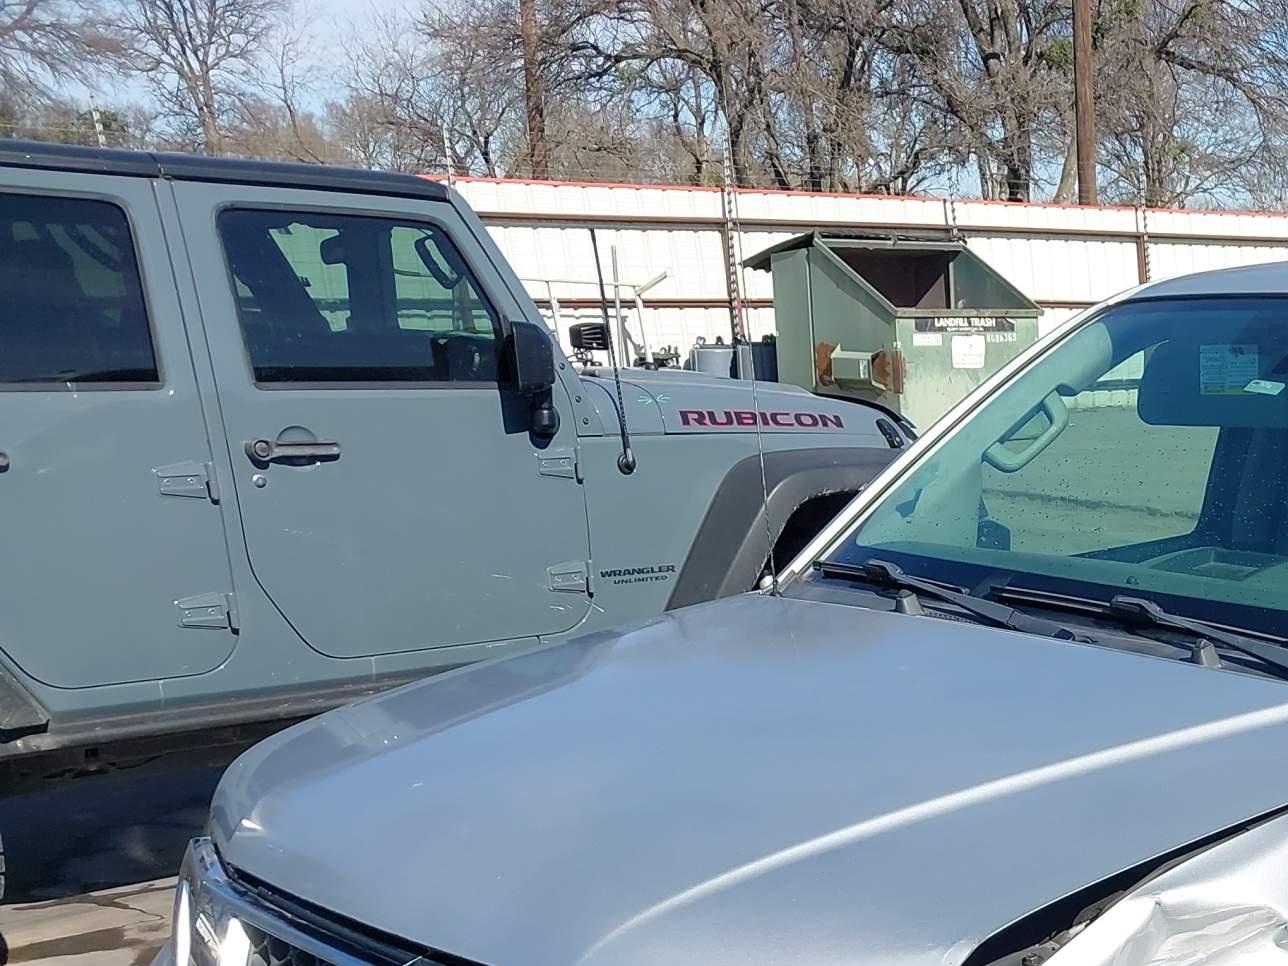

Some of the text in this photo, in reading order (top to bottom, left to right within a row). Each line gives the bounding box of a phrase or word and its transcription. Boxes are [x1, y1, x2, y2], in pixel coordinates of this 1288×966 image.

[934, 317, 996, 327] LANDFILL TRASH
[679, 410, 845, 429] RUBICON
[600, 564, 675, 578] WRANGLER
[614, 575, 667, 585] UNLIMITED
